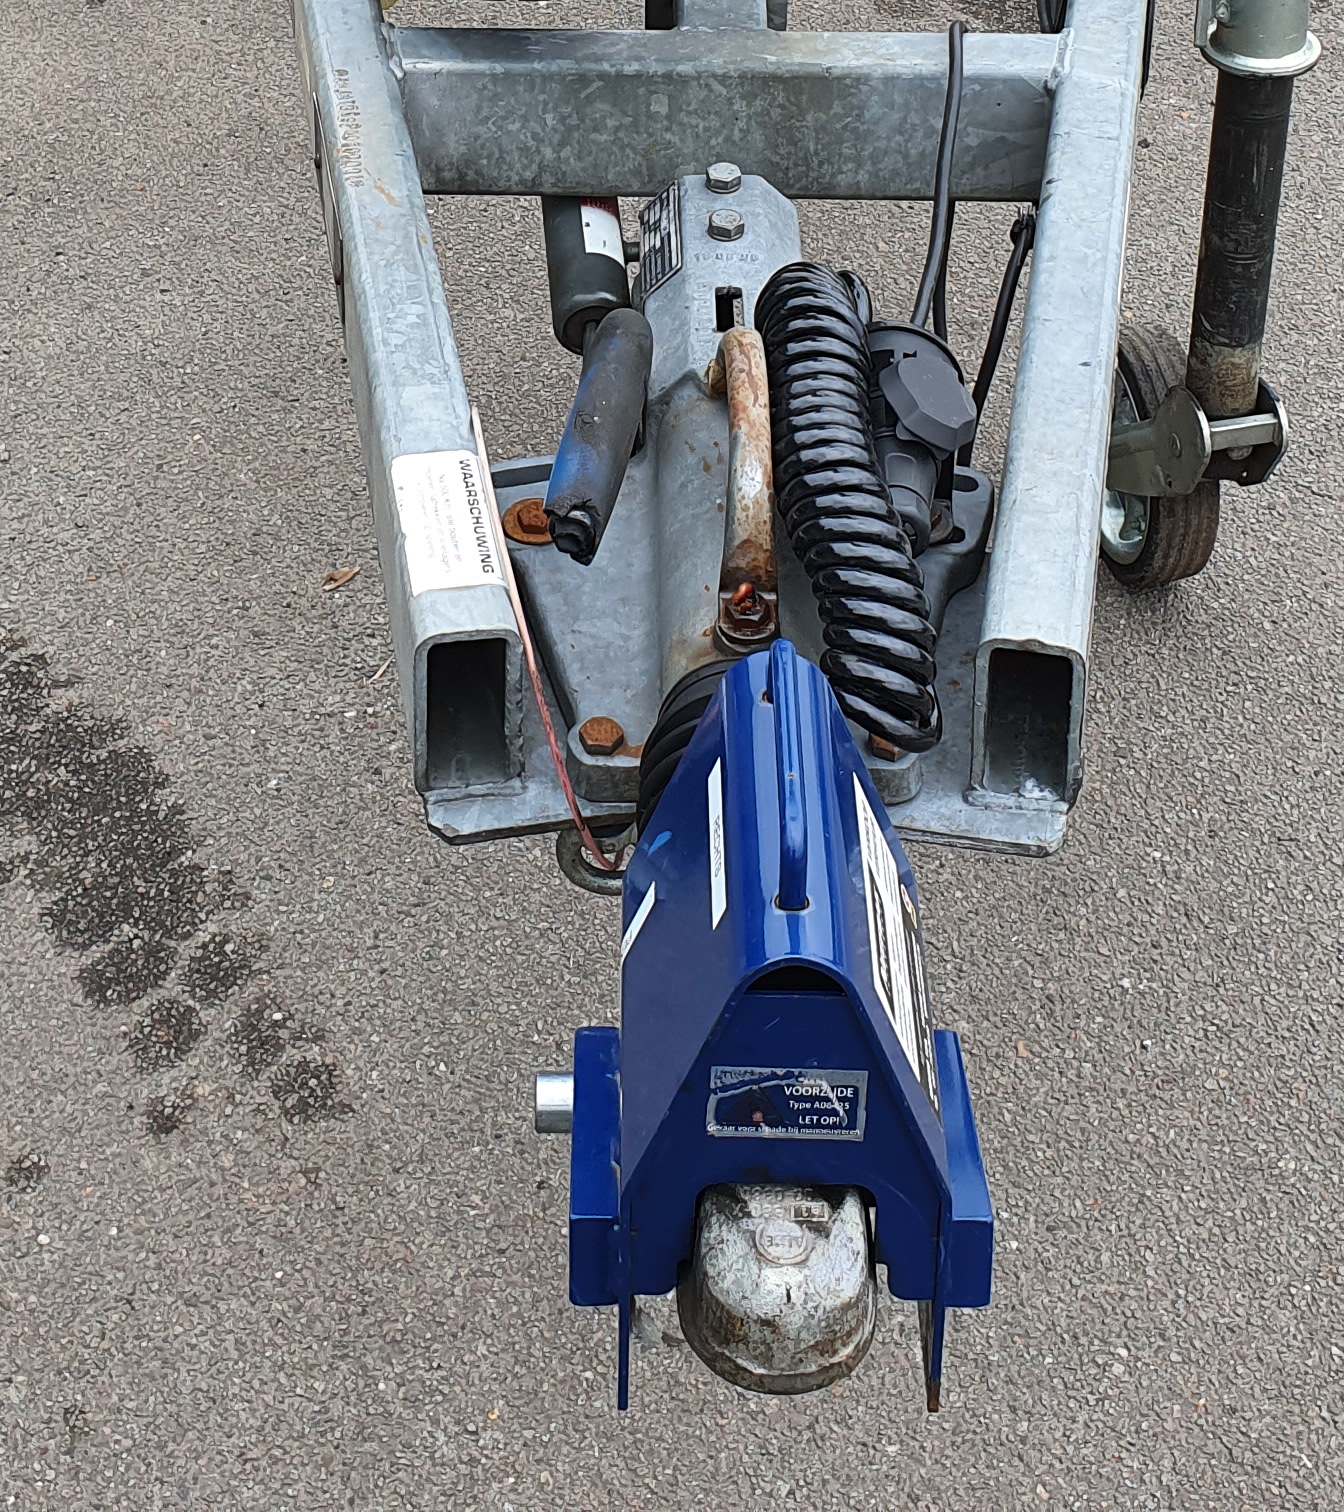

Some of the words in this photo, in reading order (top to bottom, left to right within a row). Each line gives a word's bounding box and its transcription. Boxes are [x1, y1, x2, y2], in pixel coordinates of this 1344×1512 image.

[459, 458, 494, 574] WAARSCHUWING
[712, 814, 722, 878] RECHTS
[784, 1085, 854, 1098] VOORZJDE
[789, 1100, 811, 1109] Type
[799, 1116, 818, 1125] LET
